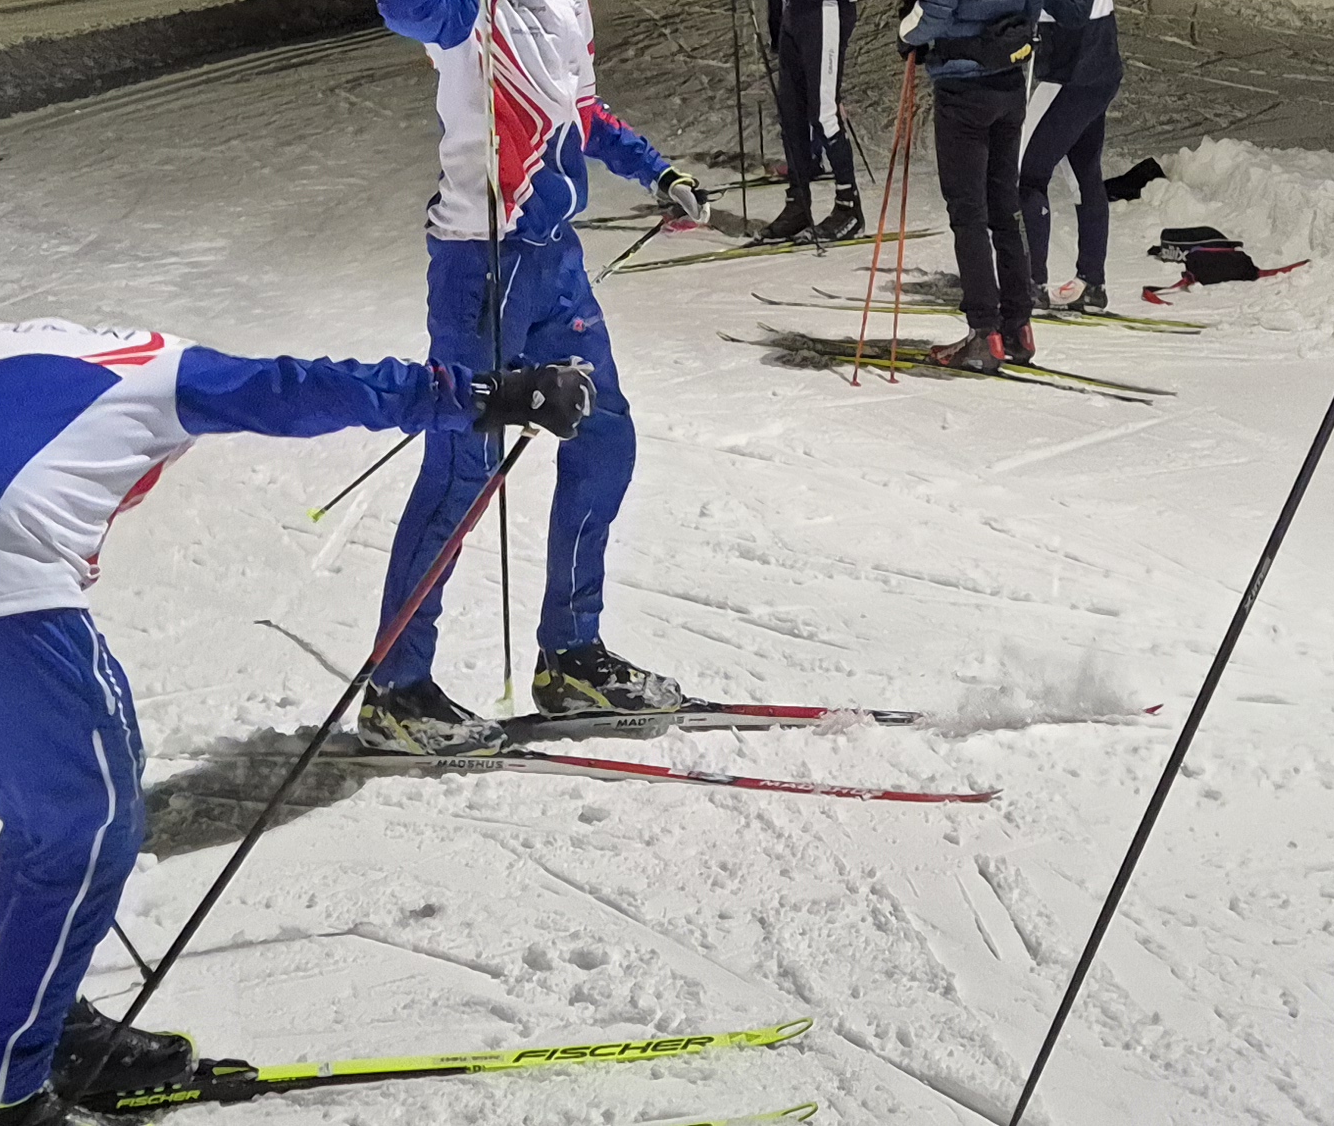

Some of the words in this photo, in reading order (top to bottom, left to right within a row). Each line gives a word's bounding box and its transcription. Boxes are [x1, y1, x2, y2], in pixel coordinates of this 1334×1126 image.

[436, 759, 504, 770] MADSHUS
[513, 1035, 715, 1063] FISCHER
[117, 1089, 202, 1109] FISCHER
